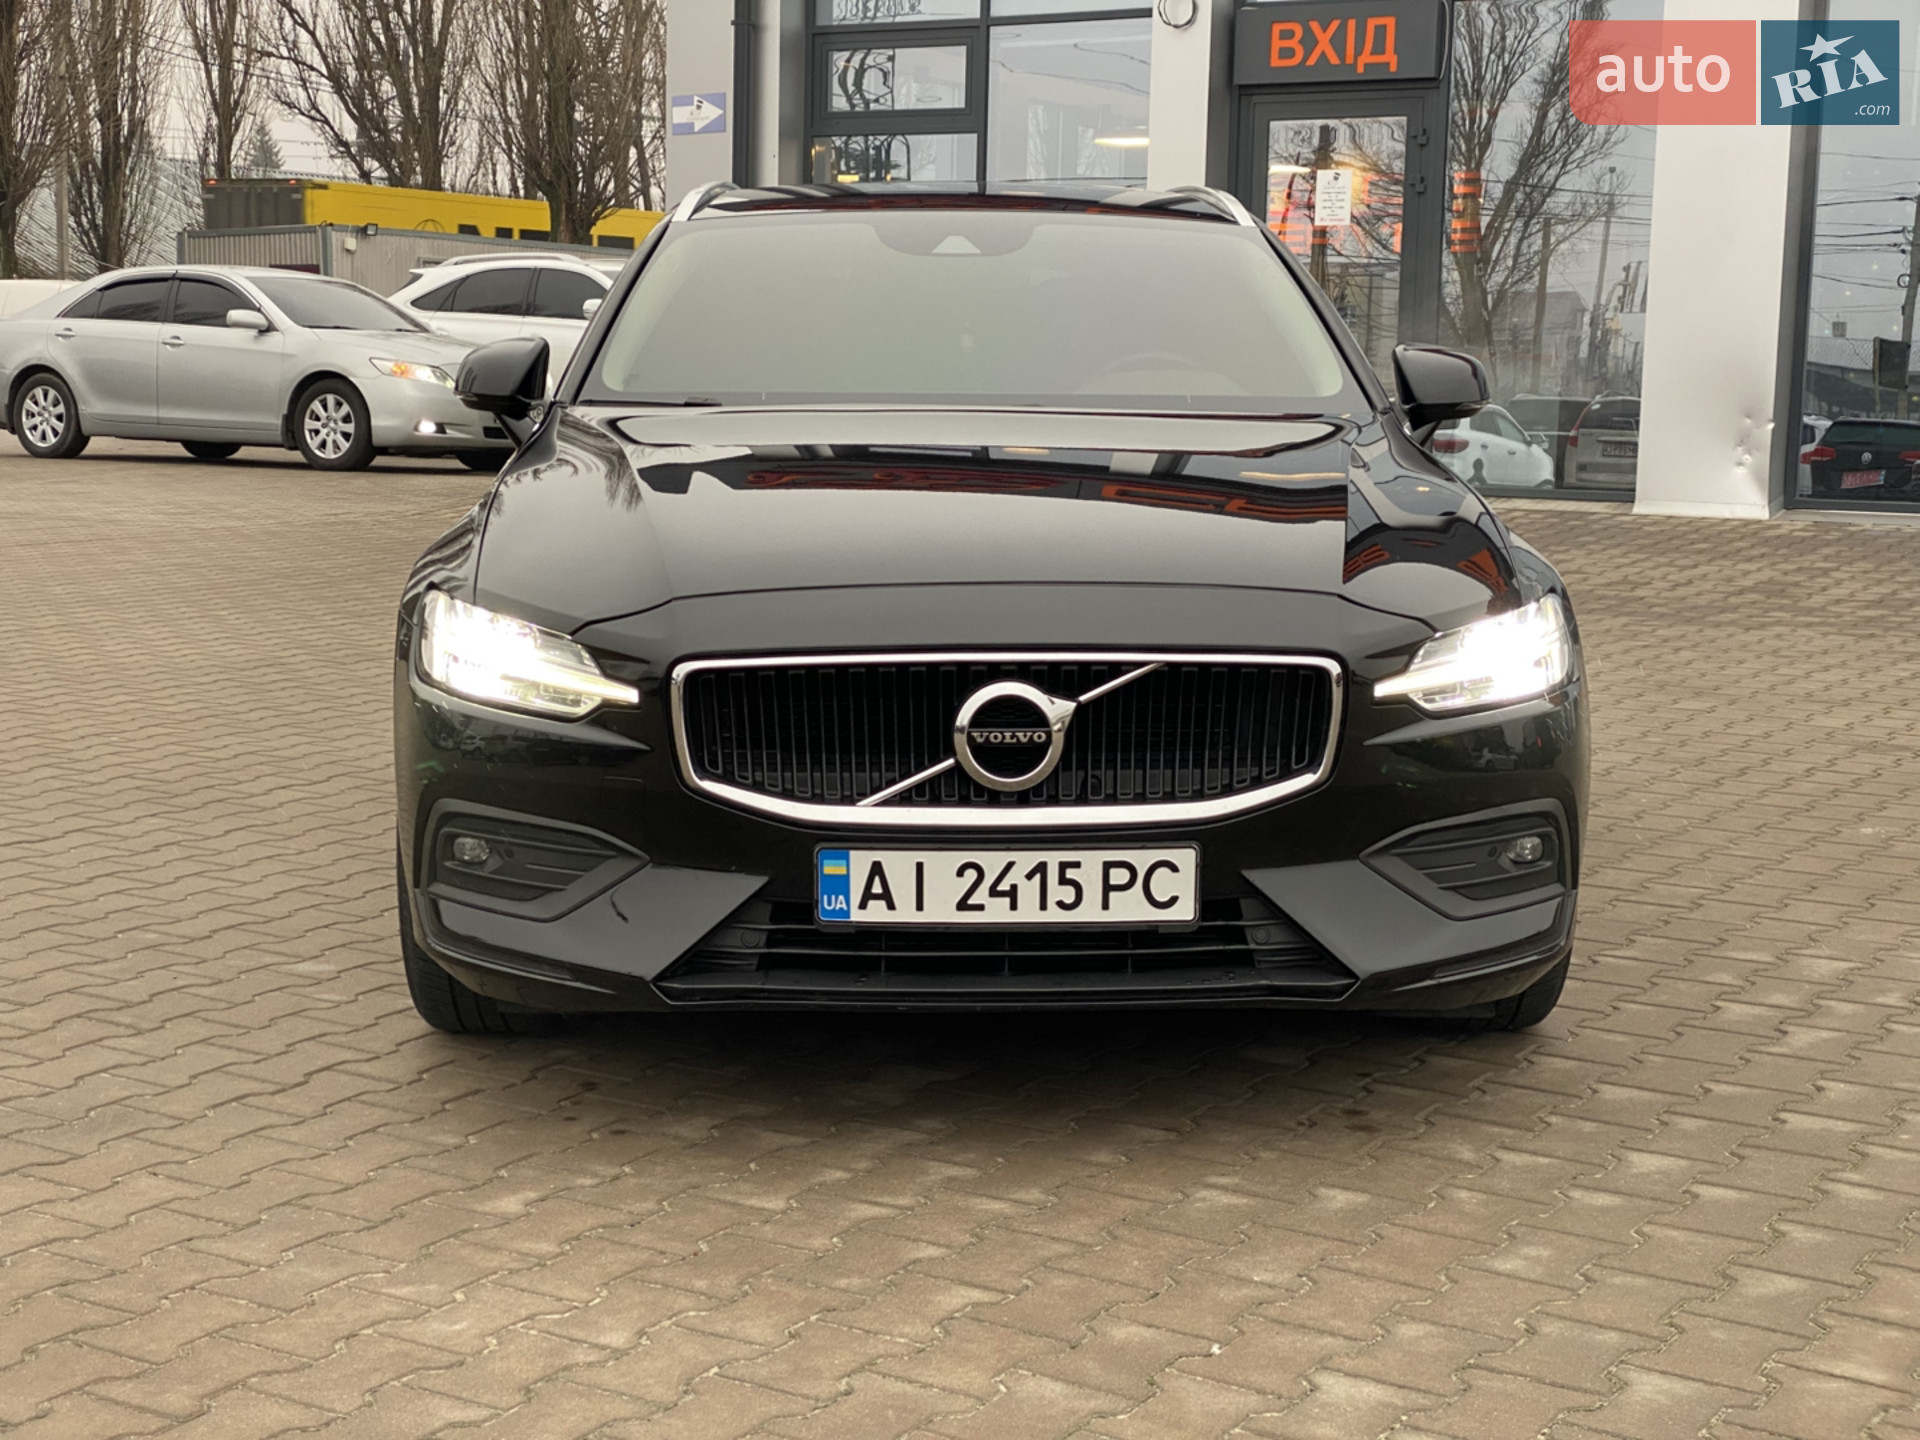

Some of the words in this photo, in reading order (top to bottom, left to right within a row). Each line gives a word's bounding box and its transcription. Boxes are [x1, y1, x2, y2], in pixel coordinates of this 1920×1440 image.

[1269, 16, 1398, 74] ВХІД
[971, 731, 1047, 744] VOLVO
[823, 894, 848, 911] UA
[955, 860, 1083, 912] 2415
[1100, 859, 1180, 911] PC
